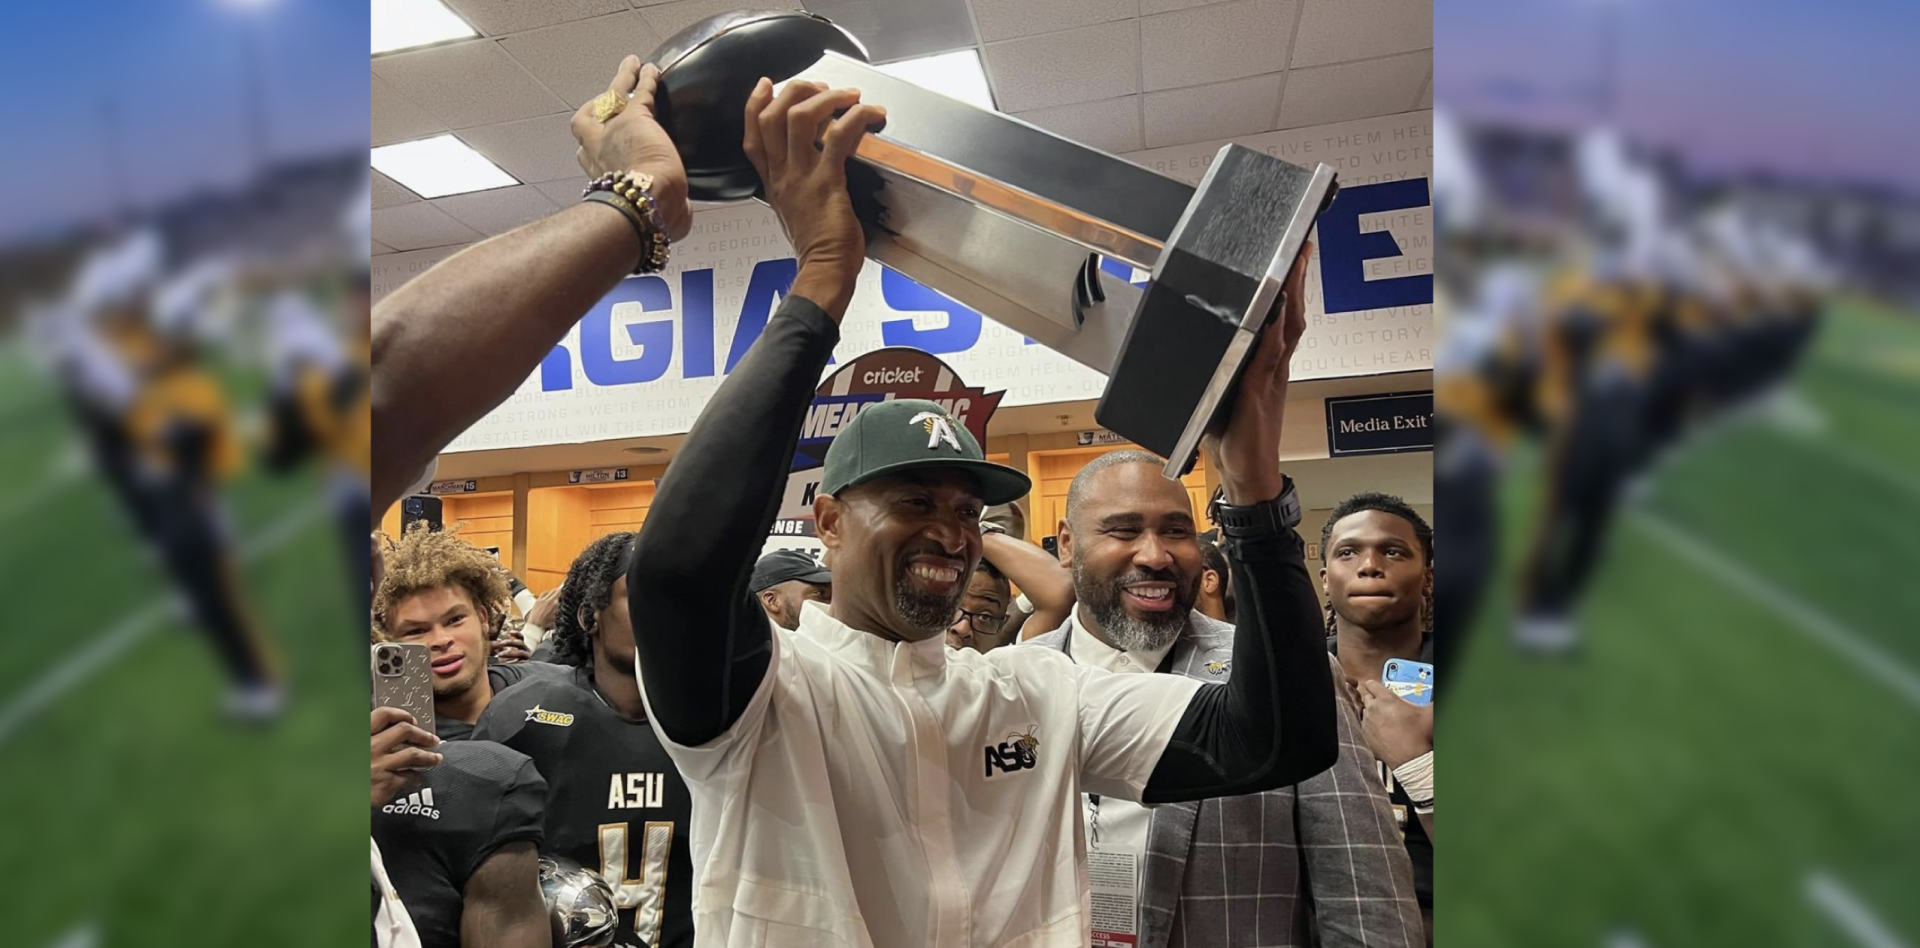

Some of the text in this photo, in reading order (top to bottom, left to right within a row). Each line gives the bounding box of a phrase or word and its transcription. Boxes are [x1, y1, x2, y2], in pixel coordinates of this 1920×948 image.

[1267, 140, 1314, 156] GIVE
[1324, 130, 1381, 149] THEM
[1334, 155, 1361, 170] TO
[692, 218, 753, 236] MIGHTY
[708, 234, 779, 253] GEORGIA
[1329, 326, 1423, 347] VICTORY
[1373, 348, 1431, 365] HEAR
[863, 366, 924, 385] cricket
[969, 361, 1077, 382] THEM HELL
[506, 407, 568, 423] STRONG
[589, 401, 640, 416] WE'RE
[647, 396, 691, 411] FROM
[483, 430, 529, 445] STATE
[536, 426, 572, 440] WILL
[578, 424, 608, 437] WIN
[616, 420, 644, 433] THE
[1340, 413, 1428, 434] Media Exit
[616, 469, 627, 479] 13
[465, 481, 475, 491] 15
[538, 711, 572, 725] SWAC
[985, 741, 1036, 778] ASU
[607, 772, 664, 809] ASU
[382, 802, 441, 820] adidas
[598, 821, 674, 948] 4
